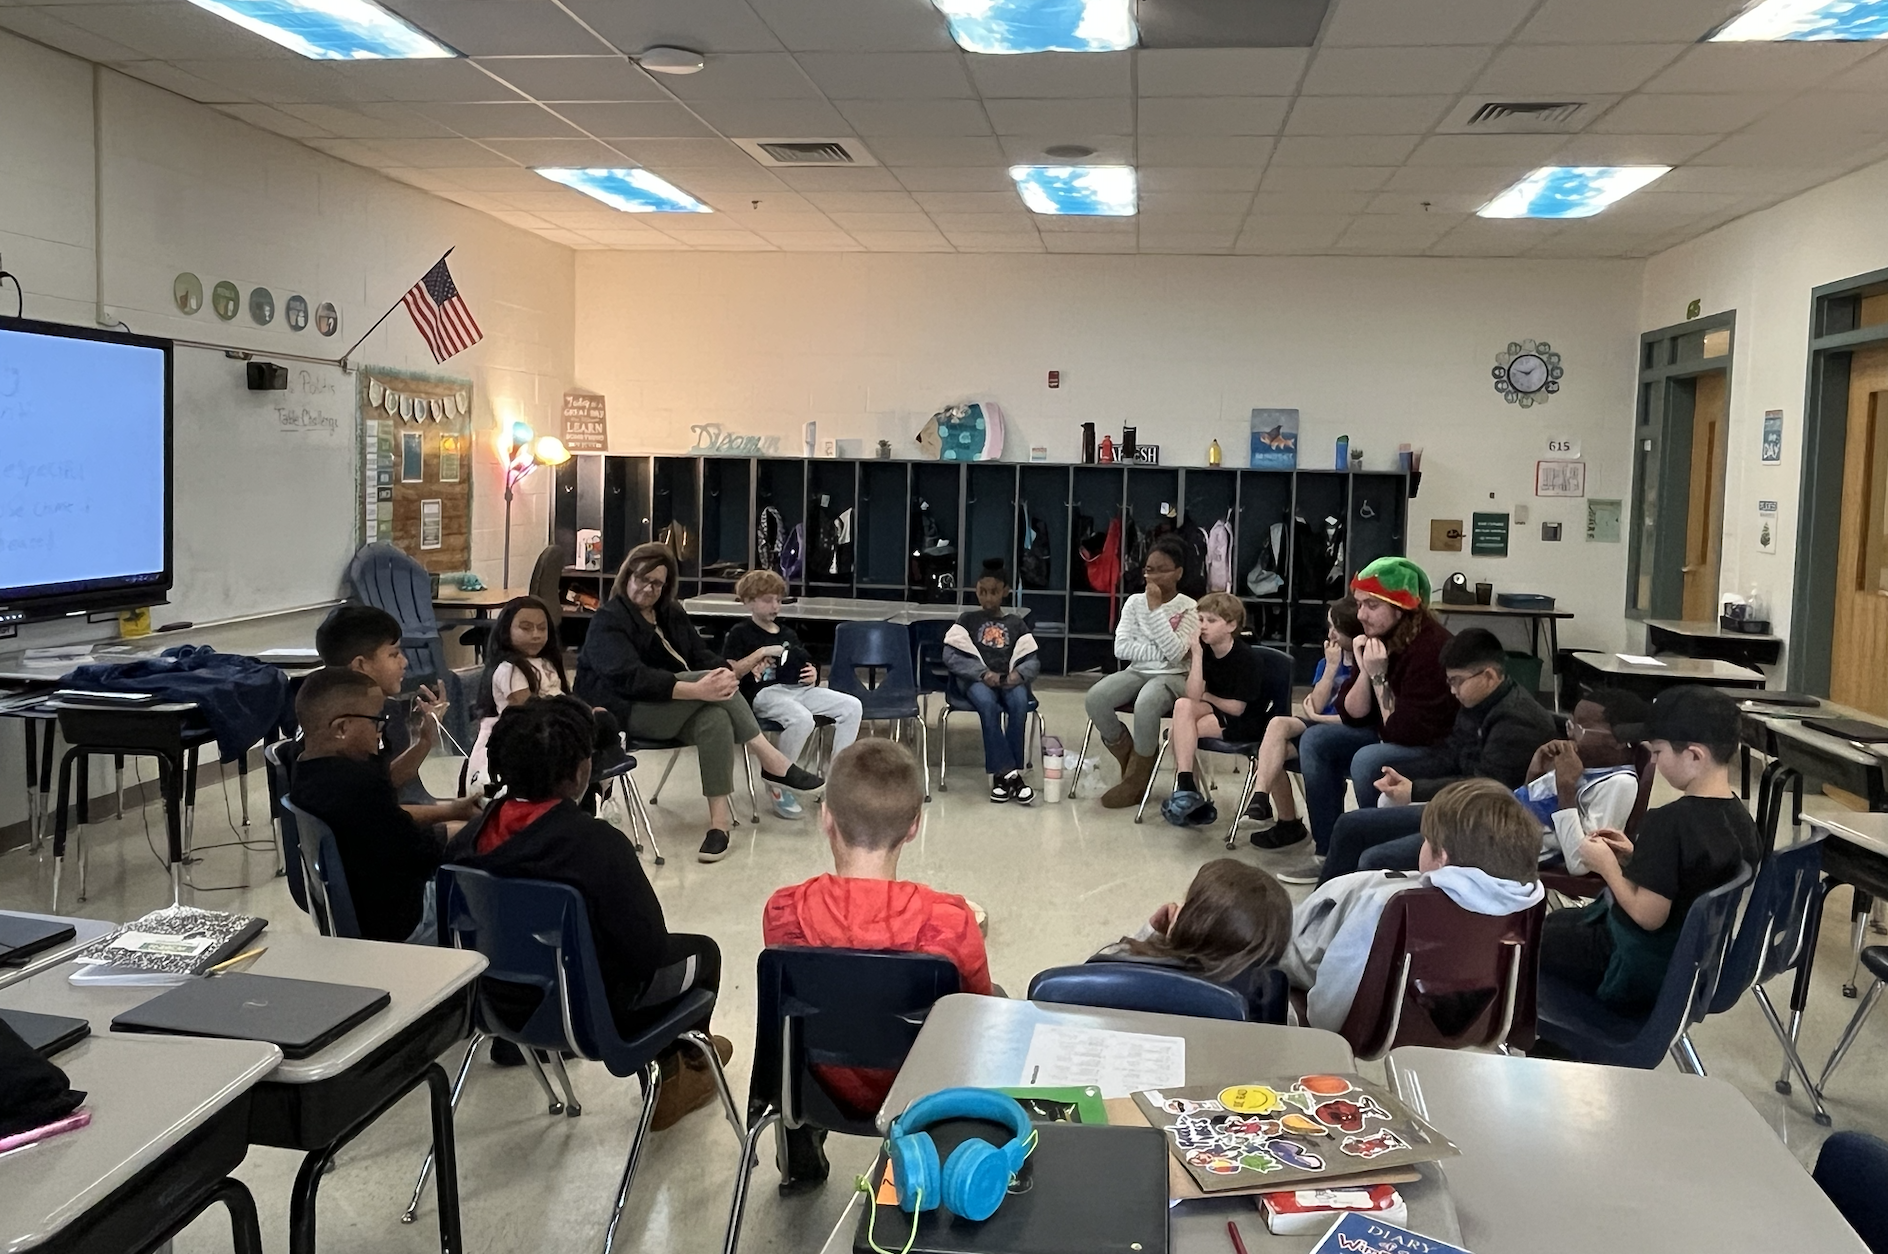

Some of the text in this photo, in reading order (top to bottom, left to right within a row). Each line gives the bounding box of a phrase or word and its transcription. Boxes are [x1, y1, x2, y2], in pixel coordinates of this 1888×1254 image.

[566, 421, 603, 433] LEARN
[1549, 441, 1571, 452] 615
[1367, 1225, 1437, 1254] DIARY
